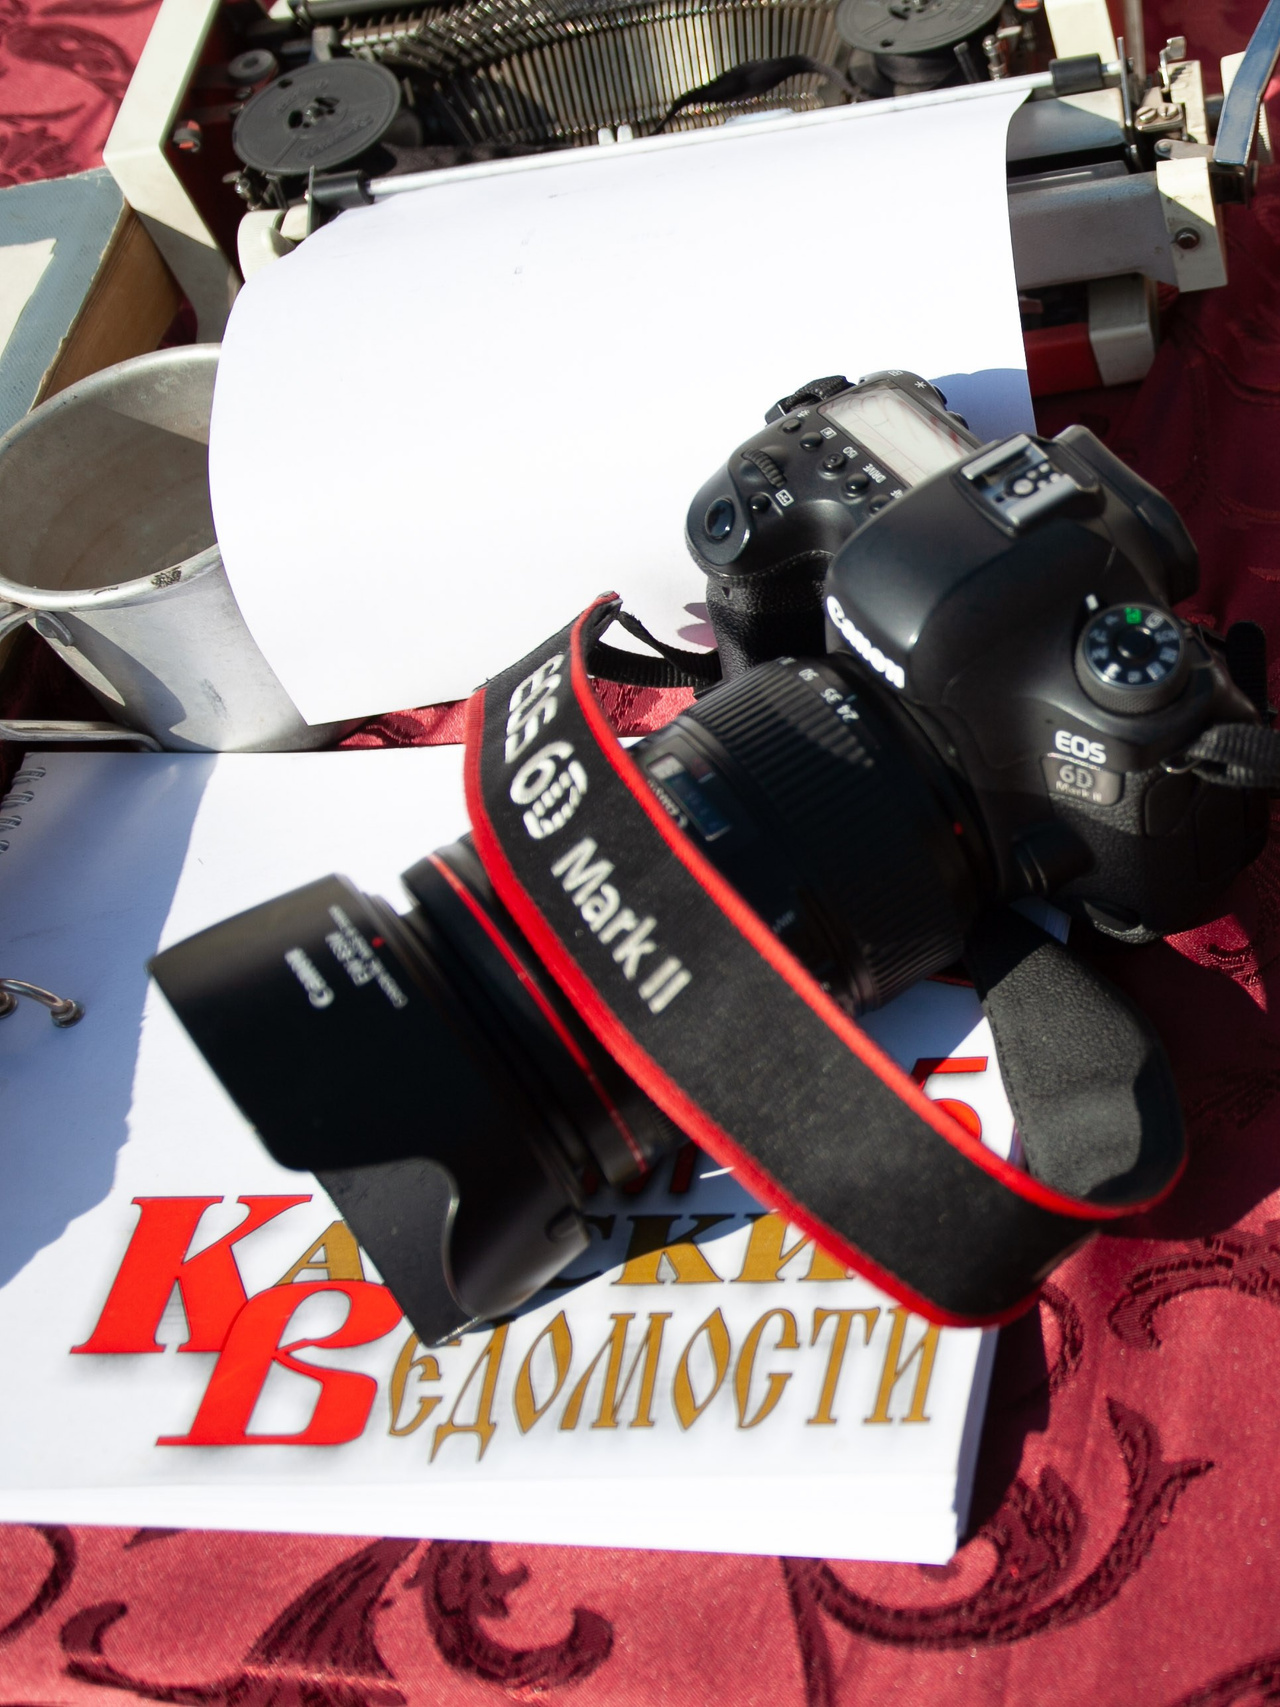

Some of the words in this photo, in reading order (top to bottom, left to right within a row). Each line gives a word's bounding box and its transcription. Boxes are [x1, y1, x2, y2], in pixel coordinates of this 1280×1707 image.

[862, 463, 886, 483] DRIVE
[827, 595, 906, 689] Canon
[504, 653, 564, 763] EOS
[837, 704, 860, 722] 24
[1055, 730, 1107, 765] EOS
[1059, 764, 1094, 790] 6D
[510, 741, 588, 839] 6D
[550, 837, 656, 980] Mark
